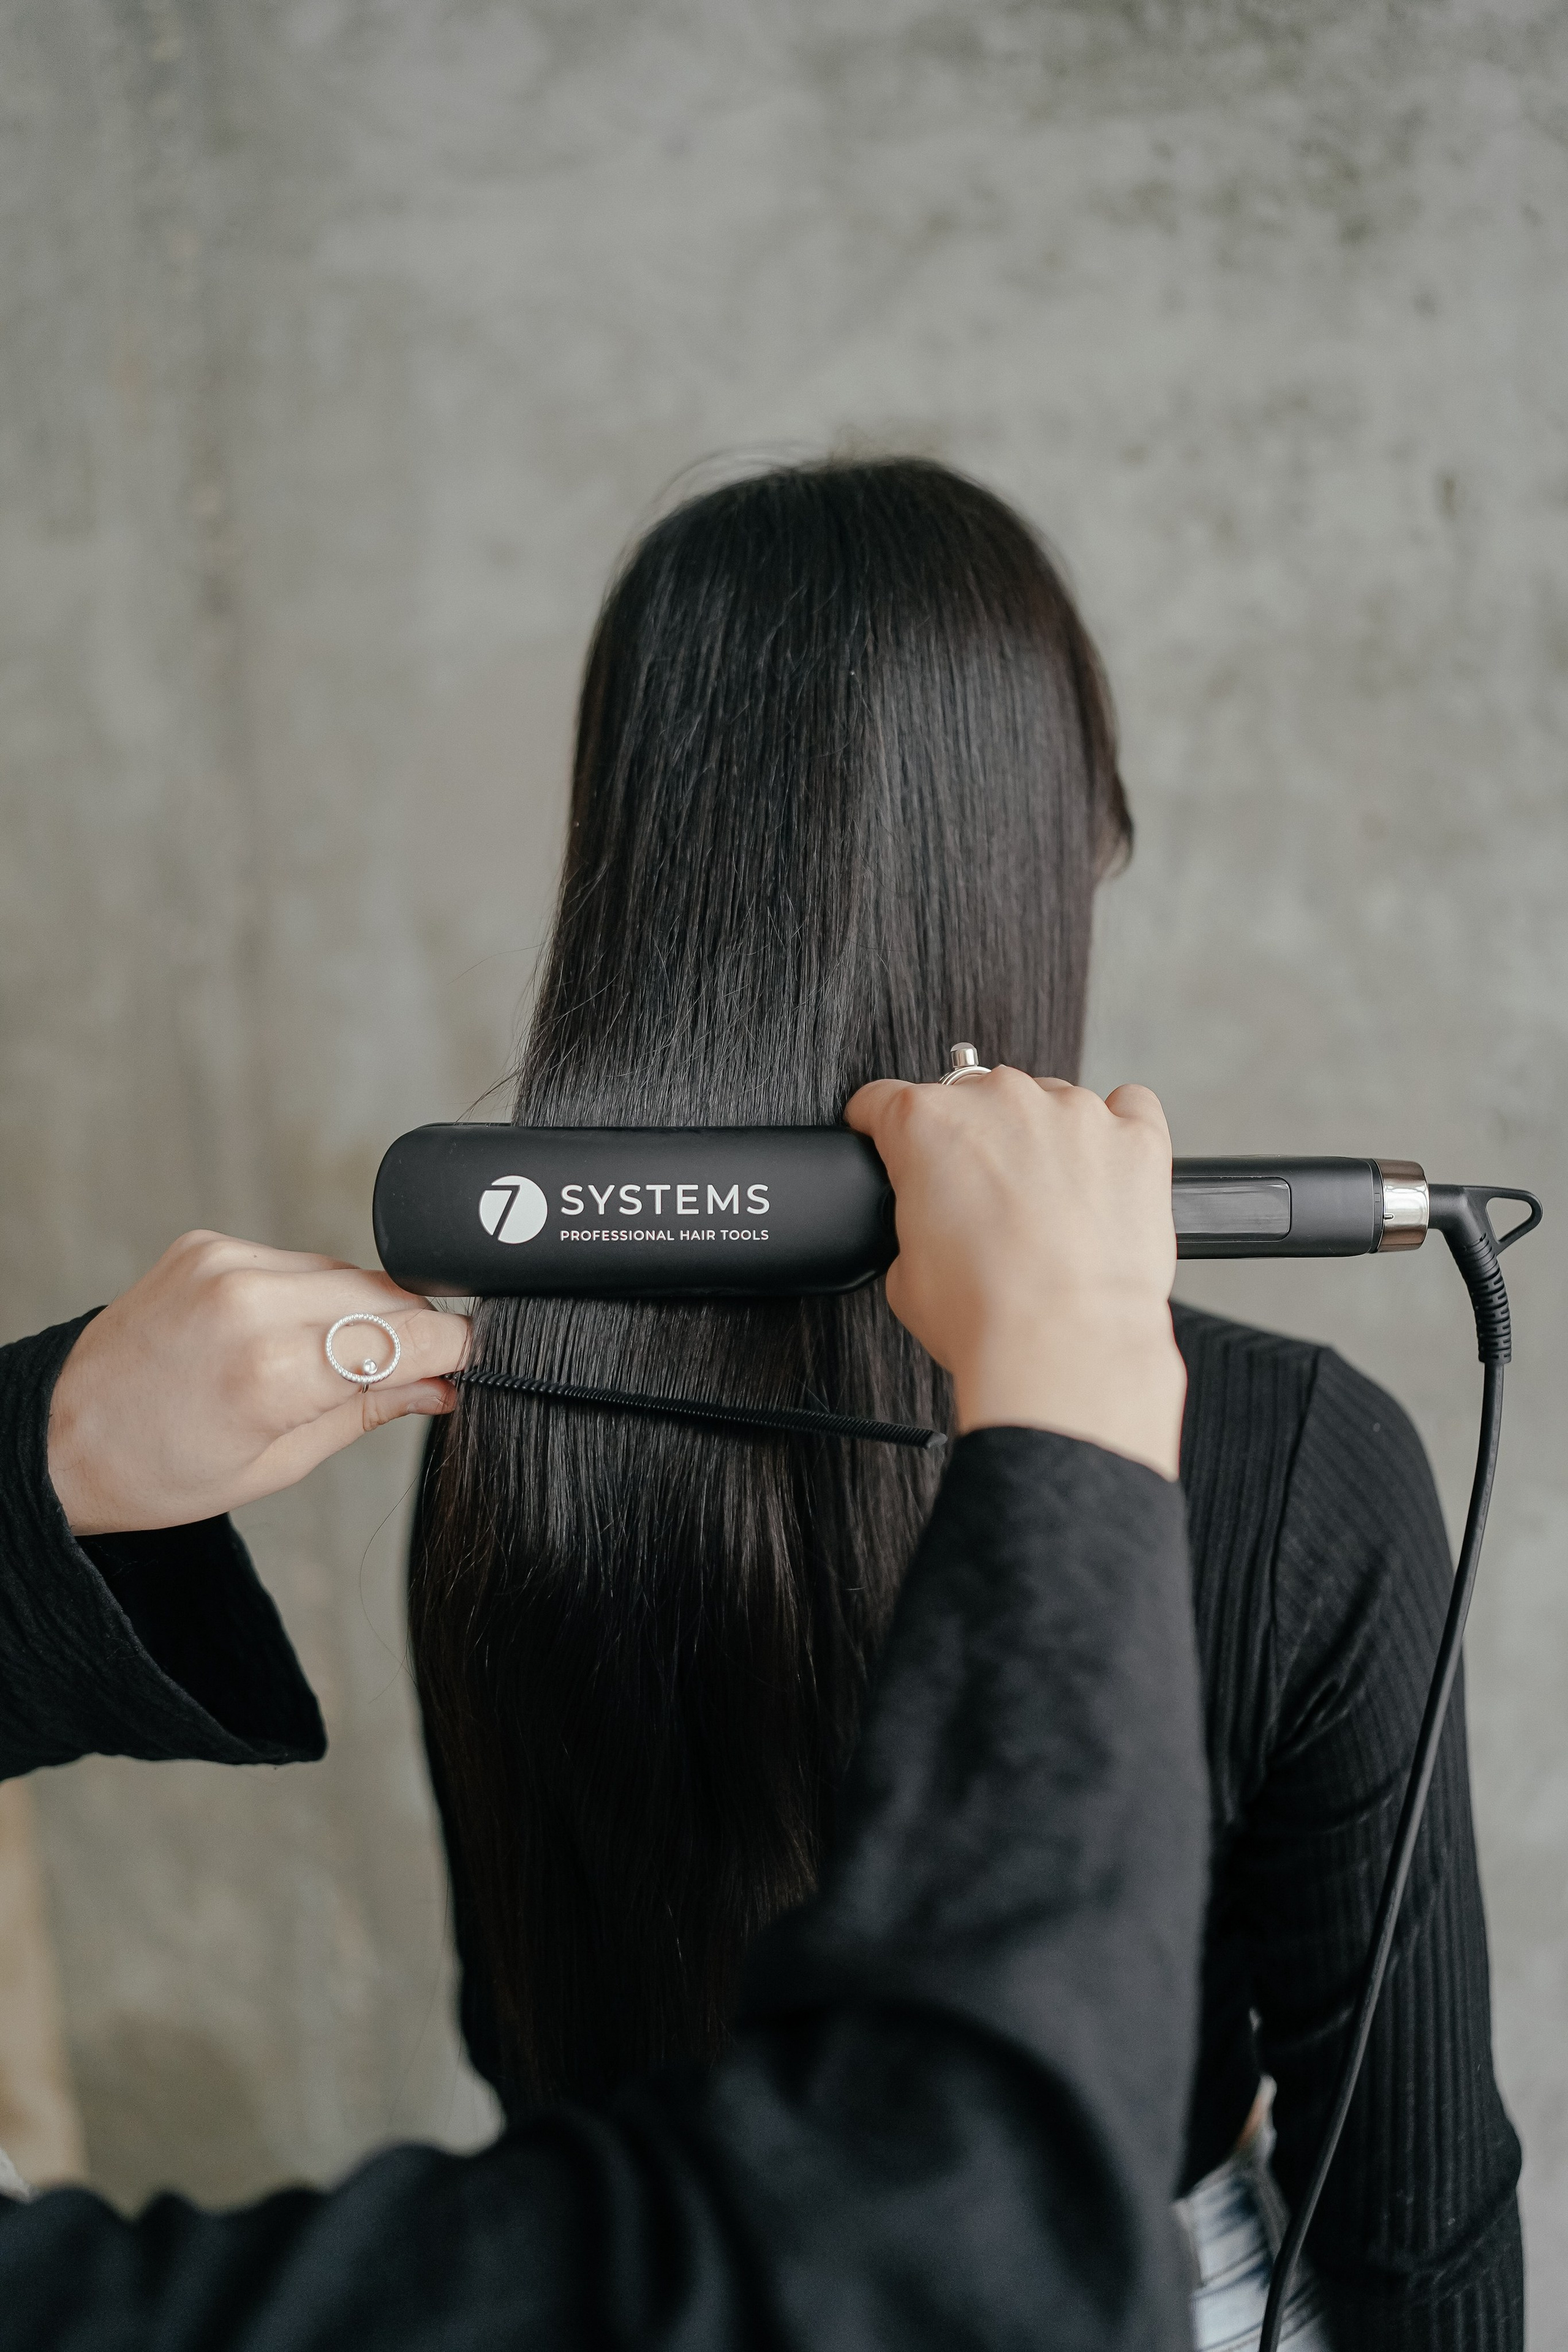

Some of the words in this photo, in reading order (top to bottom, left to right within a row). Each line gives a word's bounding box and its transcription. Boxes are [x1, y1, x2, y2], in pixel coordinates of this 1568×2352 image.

[560, 1183, 771, 1216] SYSTEMS
[560, 1229, 675, 1242] PROFESSIONAL
[679, 1229, 716, 1241] HAIR
[720, 1229, 770, 1241] TOOLS
